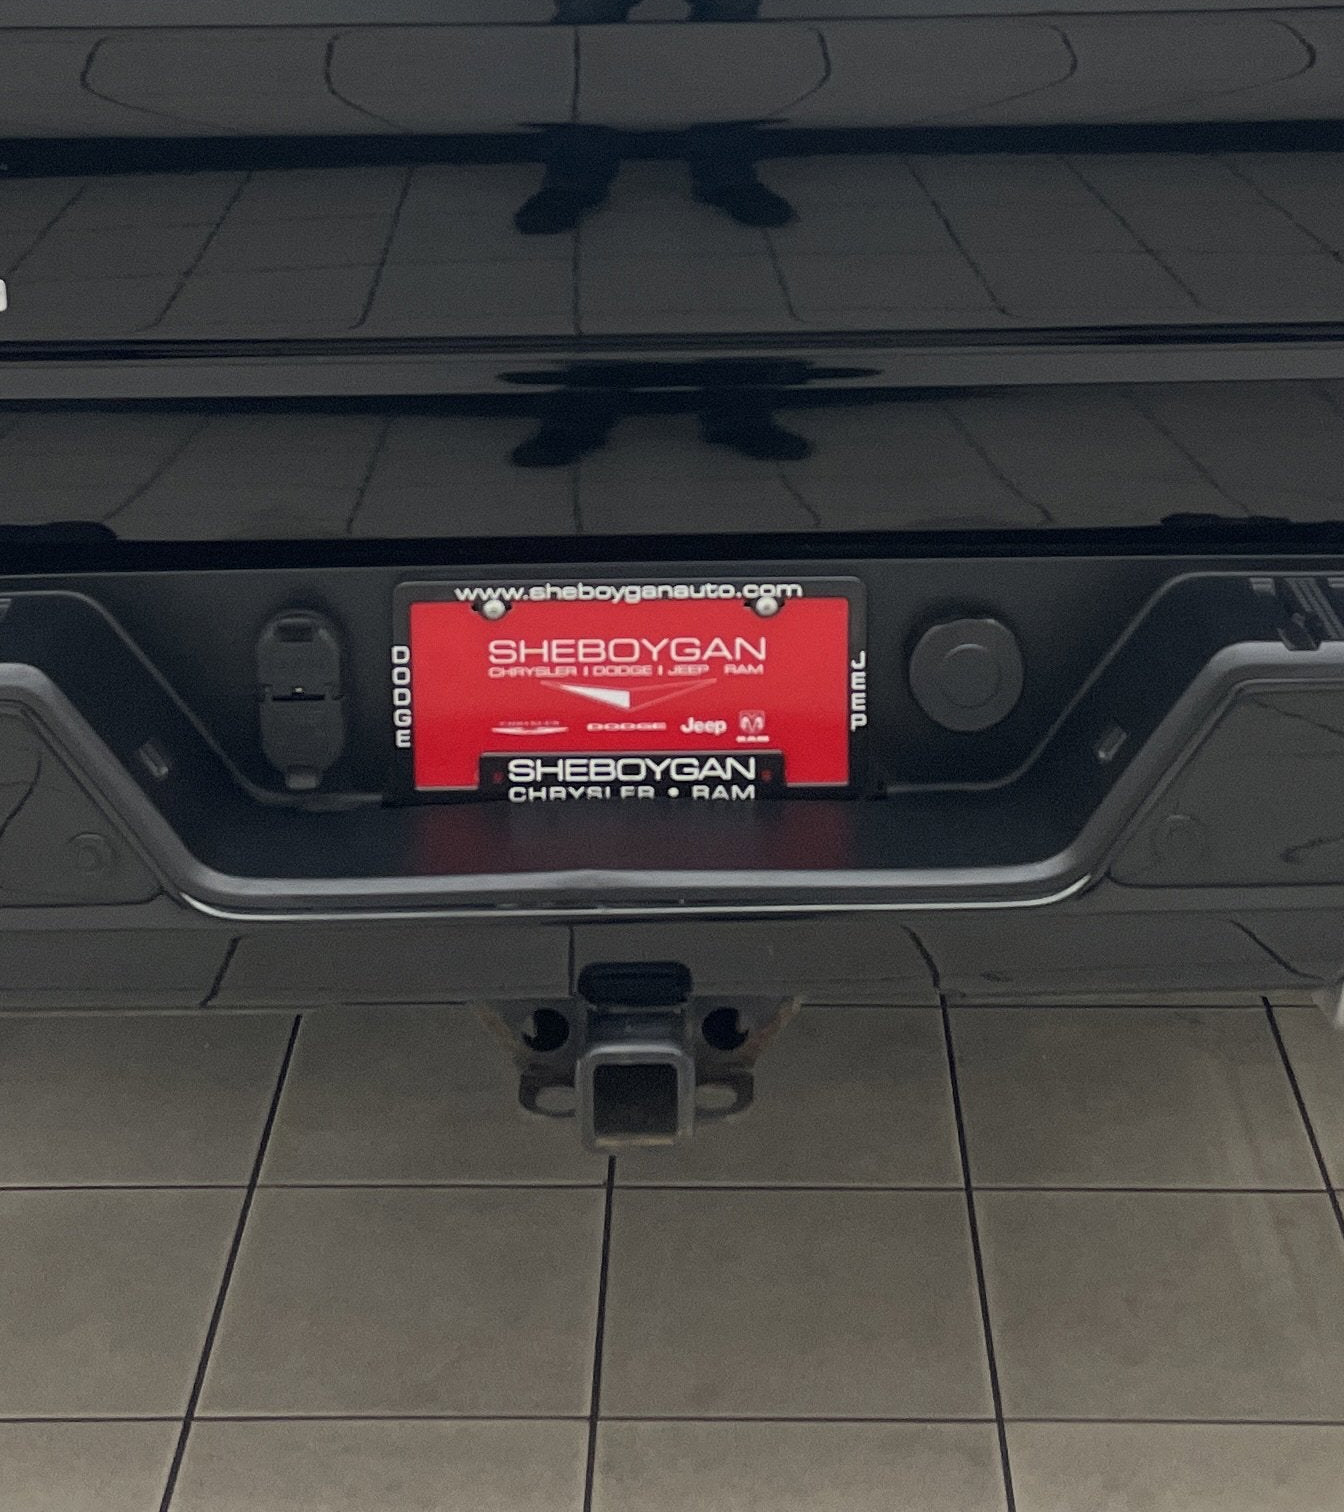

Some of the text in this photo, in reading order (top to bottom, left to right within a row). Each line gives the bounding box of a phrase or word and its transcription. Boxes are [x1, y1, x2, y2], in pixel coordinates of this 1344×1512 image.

[455, 582, 803, 603] www.sheboyganauto.com
[488, 637, 767, 664] SHEBOYGAN
[488, 664, 764, 678] CHRYSLER DODGE JEEP RAM
[392, 645, 412, 748] DODGE
[851, 650, 868, 731] JEEP
[586, 722, 668, 732] DODGE
[680, 717, 728, 736] Jeep
[508, 757, 756, 783] SHEBOYGAN
[692, 784, 756, 801] RAM
